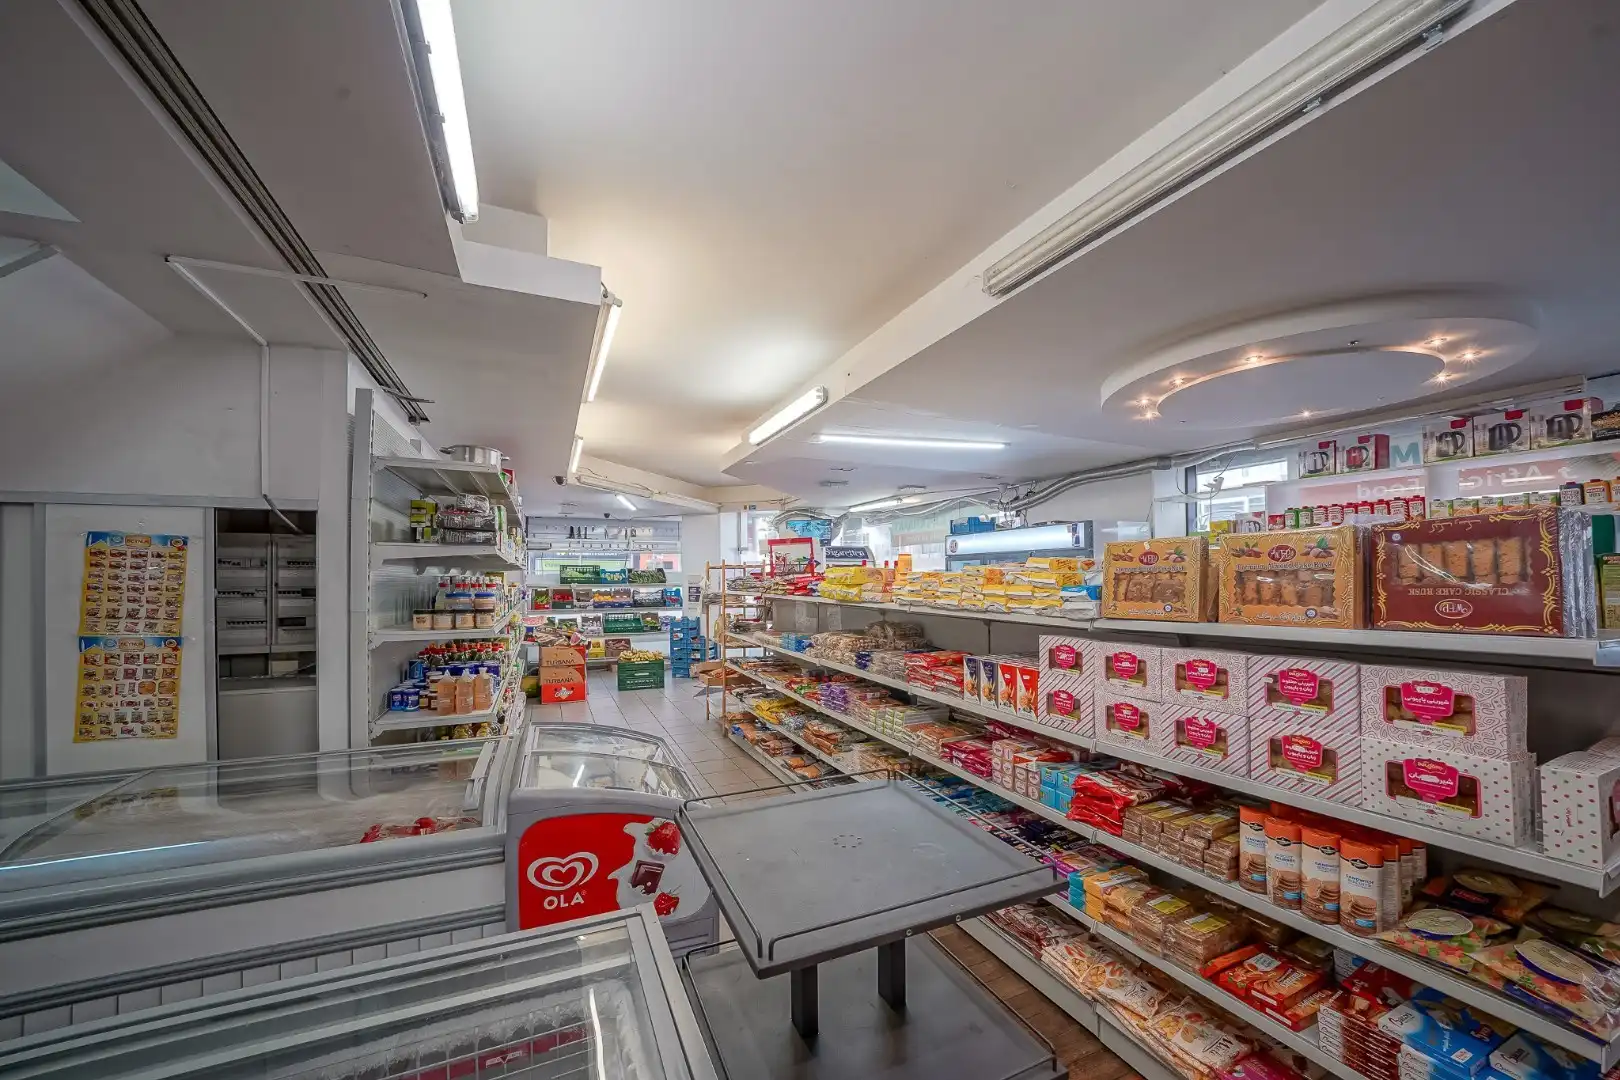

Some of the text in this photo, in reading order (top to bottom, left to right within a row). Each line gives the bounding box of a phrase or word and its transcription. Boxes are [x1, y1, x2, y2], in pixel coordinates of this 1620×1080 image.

[1407, 587, 1509, 596] CLASSIC CAKE RUSK
[543, 891, 585, 910] OLA
